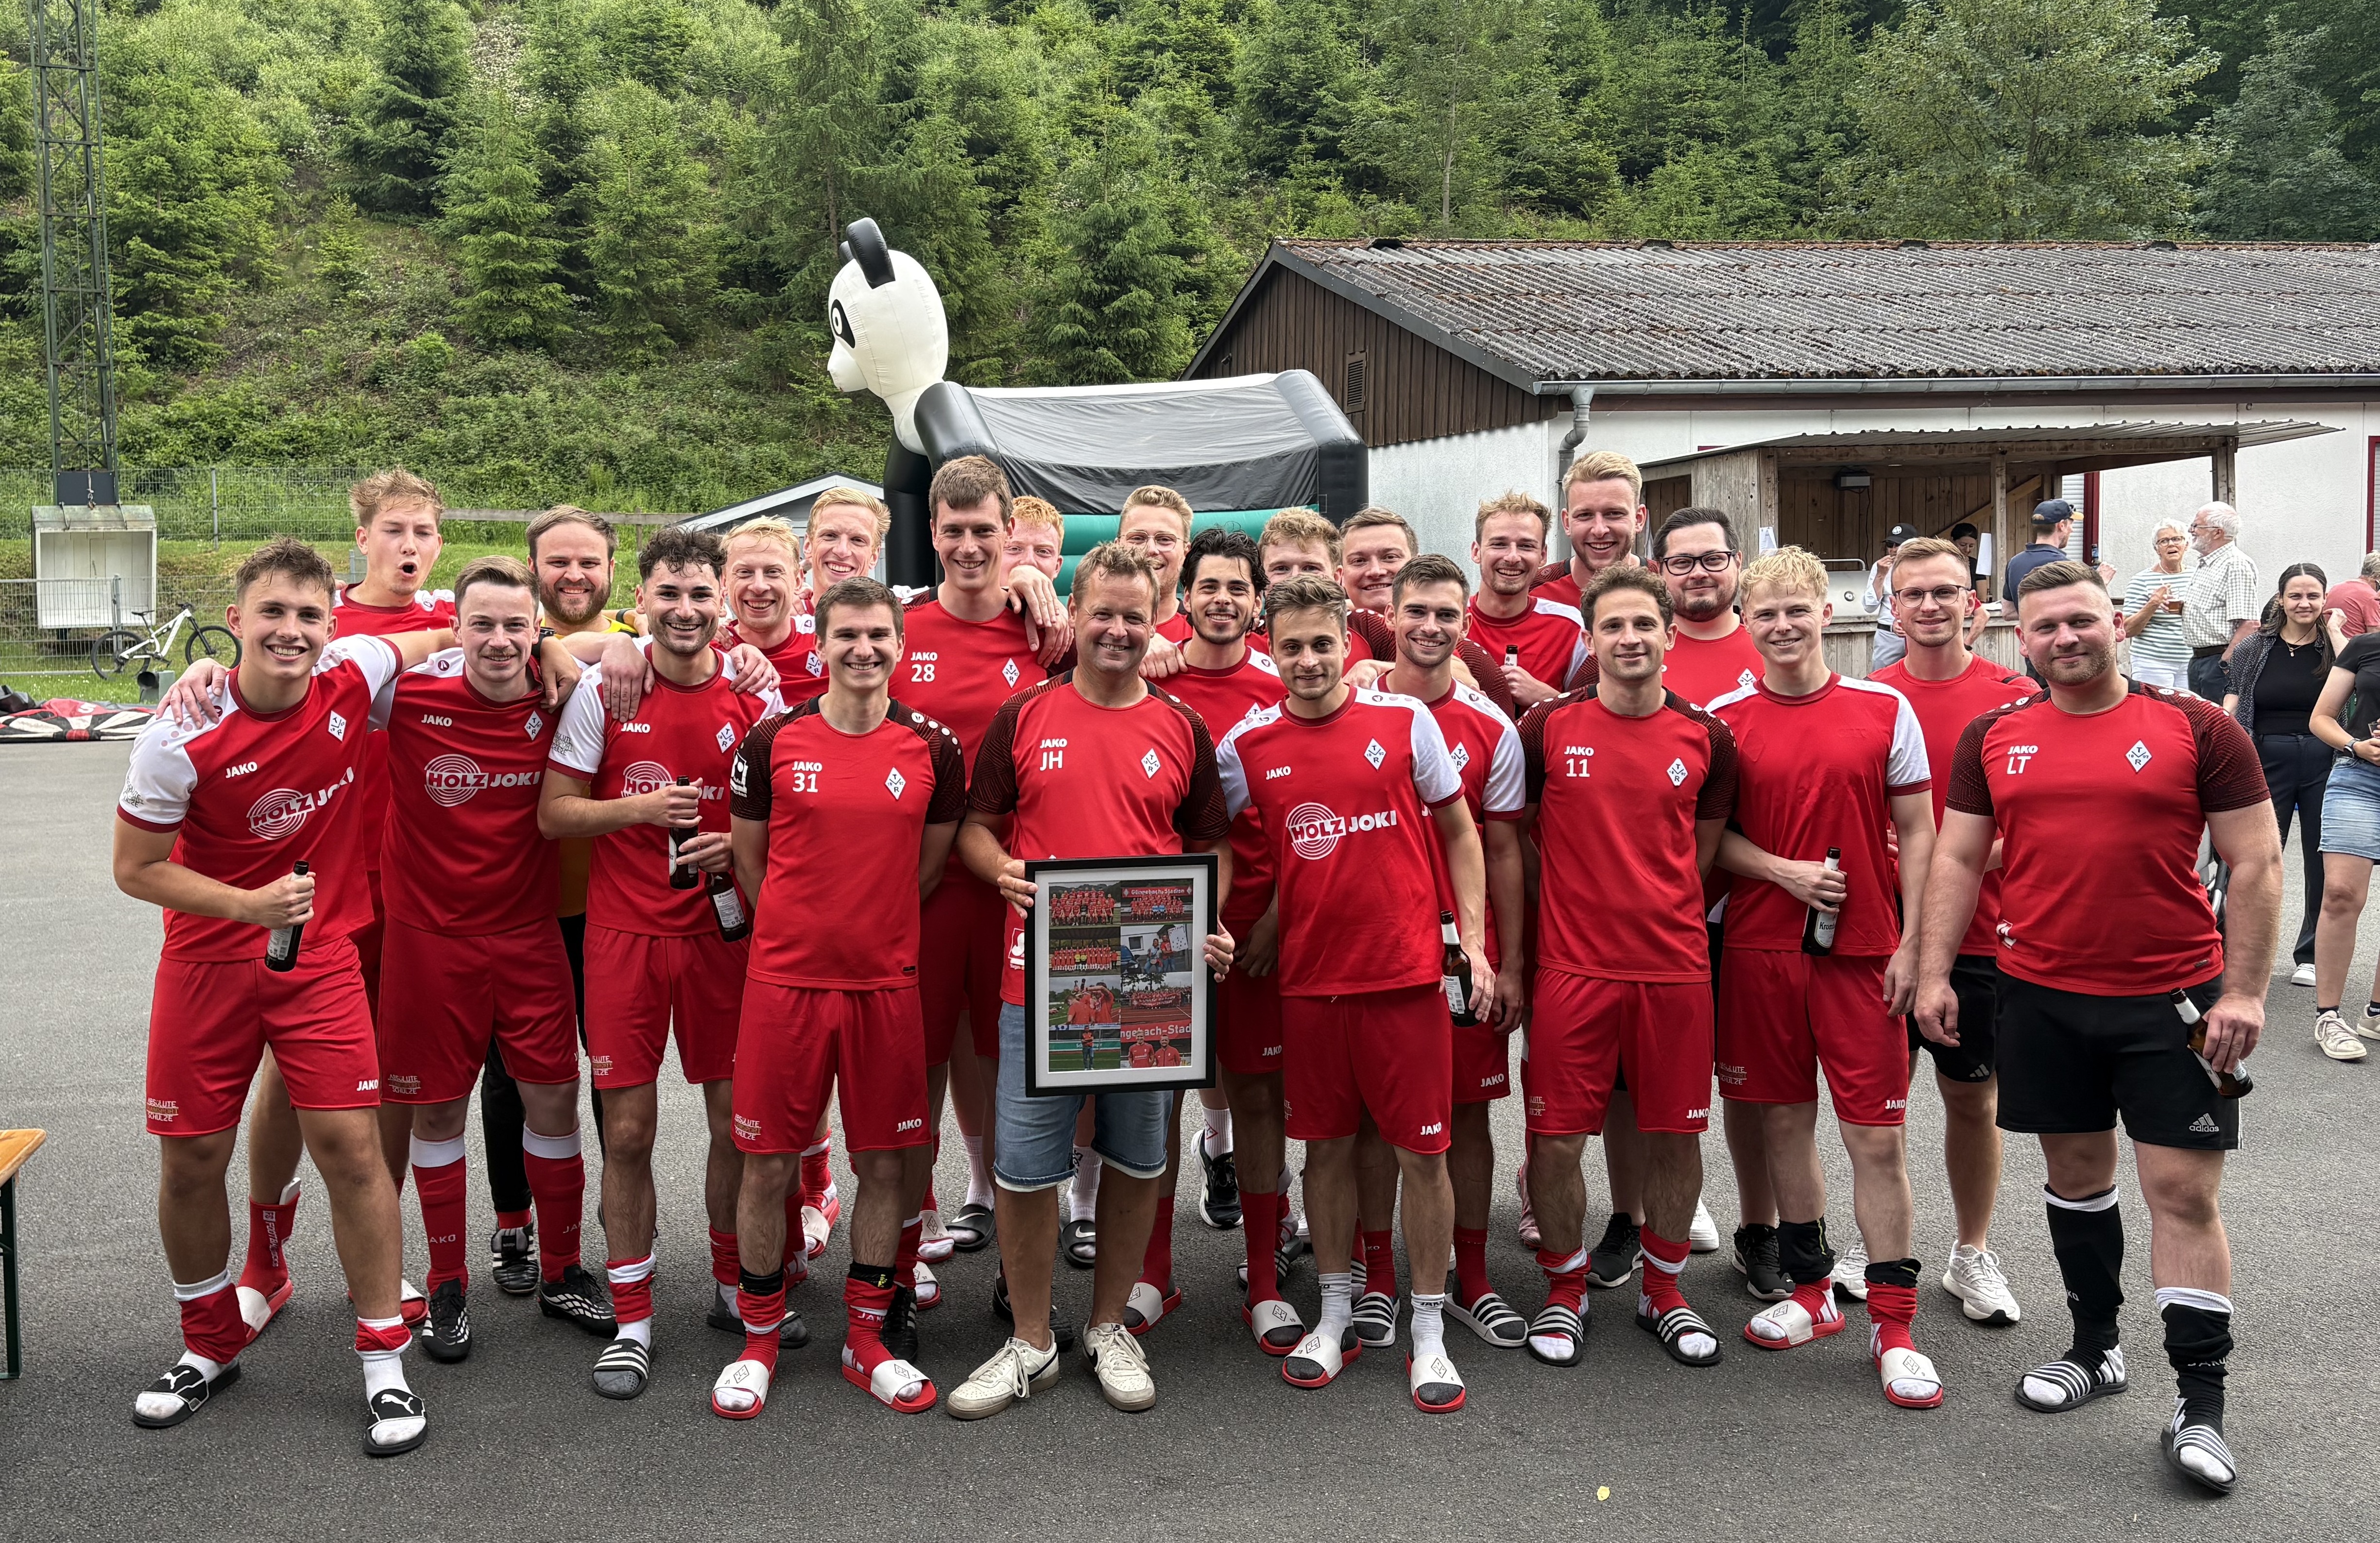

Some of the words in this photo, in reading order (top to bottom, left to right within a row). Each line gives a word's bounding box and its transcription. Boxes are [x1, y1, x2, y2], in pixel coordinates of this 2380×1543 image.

[910, 652, 938, 661] JAKO
[911, 663, 935, 682] 28
[421, 714, 452, 727] JAKO
[621, 722, 651, 734] JAKO
[1039, 738, 1068, 749] JAKO
[2007, 745, 2038, 755] JAKO
[1564, 746, 1594, 756] JAKO
[792, 761, 822, 772] JAKO
[1039, 750, 1063, 771] JH
[2007, 756, 2031, 774] LT
[225, 761, 258, 779] JAKO
[1266, 766, 1291, 780] JAKO
[1566, 758, 1590, 777] 11
[428, 772, 488, 789] HOLZ
[491, 771, 541, 788] JOKI
[792, 772, 818, 793] 31
[251, 794, 315, 829] HOLZ
[1290, 816, 1346, 843] HOLZ
[1348, 810, 1397, 833] JOKI
[1262, 1045, 1282, 1056] JAKO
[356, 1079, 379, 1092] JAKO
[1481, 1073, 1505, 1087] JAKO
[148, 1097, 176, 1107] ABSOLUTE
[1885, 1099, 1905, 1110] JAKO
[148, 1113, 173, 1122] SCHULZE
[1686, 1108, 1709, 1119] JAKO
[897, 1118, 922, 1132] JAKO
[1420, 1121, 1442, 1135] JAKO
[2189, 1124, 2220, 1132] adidas
[429, 1234, 456, 1244] AKO
